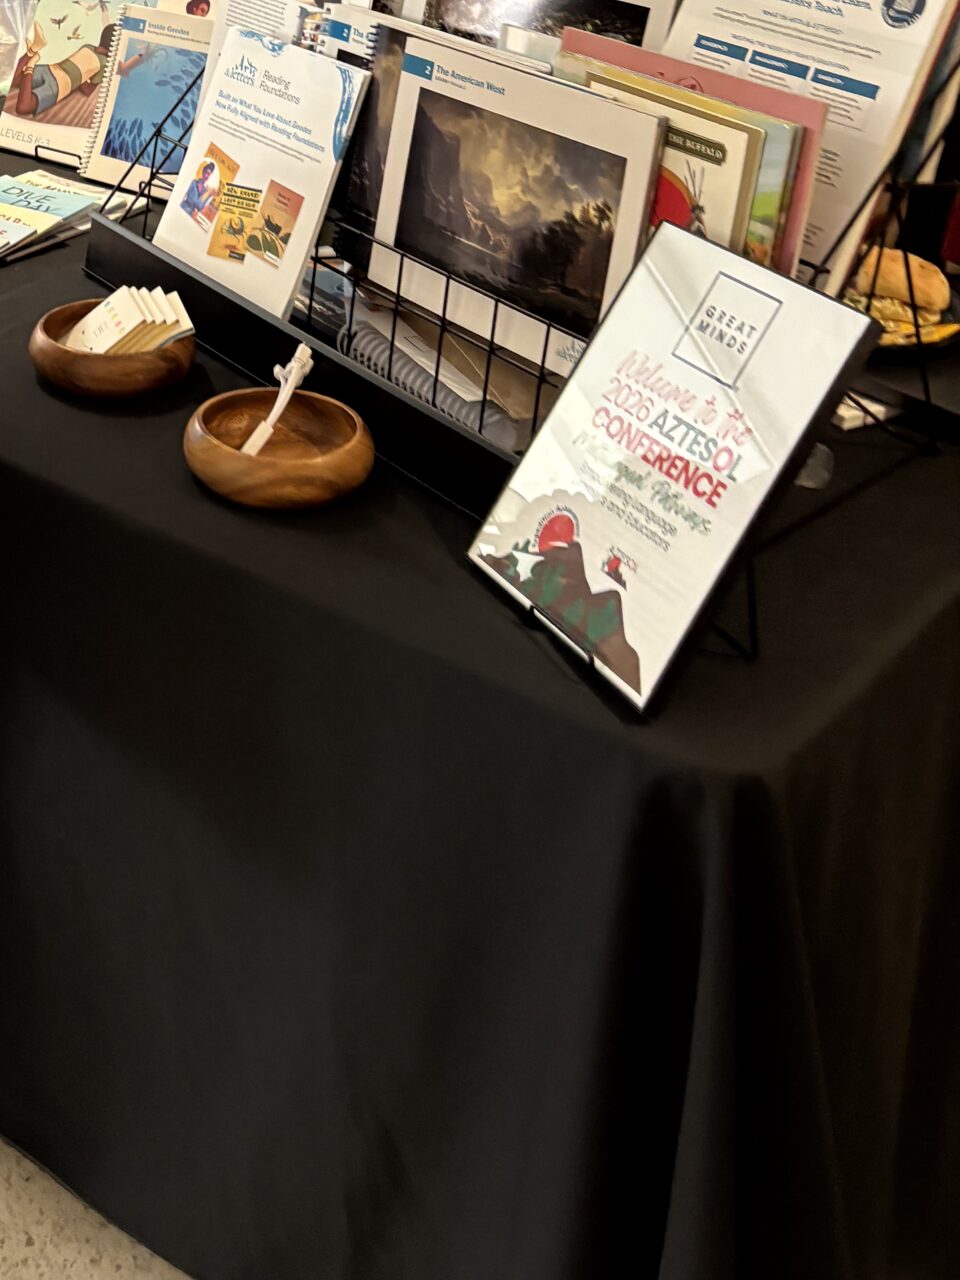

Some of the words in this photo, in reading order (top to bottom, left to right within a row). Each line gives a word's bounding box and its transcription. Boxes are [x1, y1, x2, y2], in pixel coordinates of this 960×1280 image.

[353, 27, 365, 40] The
[233, 54, 259, 78] Arts
[262, 70, 291, 91] Reading
[424, 65, 432, 76] 2
[435, 64, 449, 78] The
[449, 68, 485, 89] American
[485, 80, 506, 96] West
[258, 80, 301, 106] Foundations
[0, 128, 34, 143] LEVELS
[2, 186, 56, 204] DIVE
[697, 321, 749, 355] MINDS
[706, 304, 757, 339] GREAT
[602, 376, 655, 424] 2026
[647, 409, 743, 482] AZTESOL
[592, 406, 728, 509] CONFERENCE
